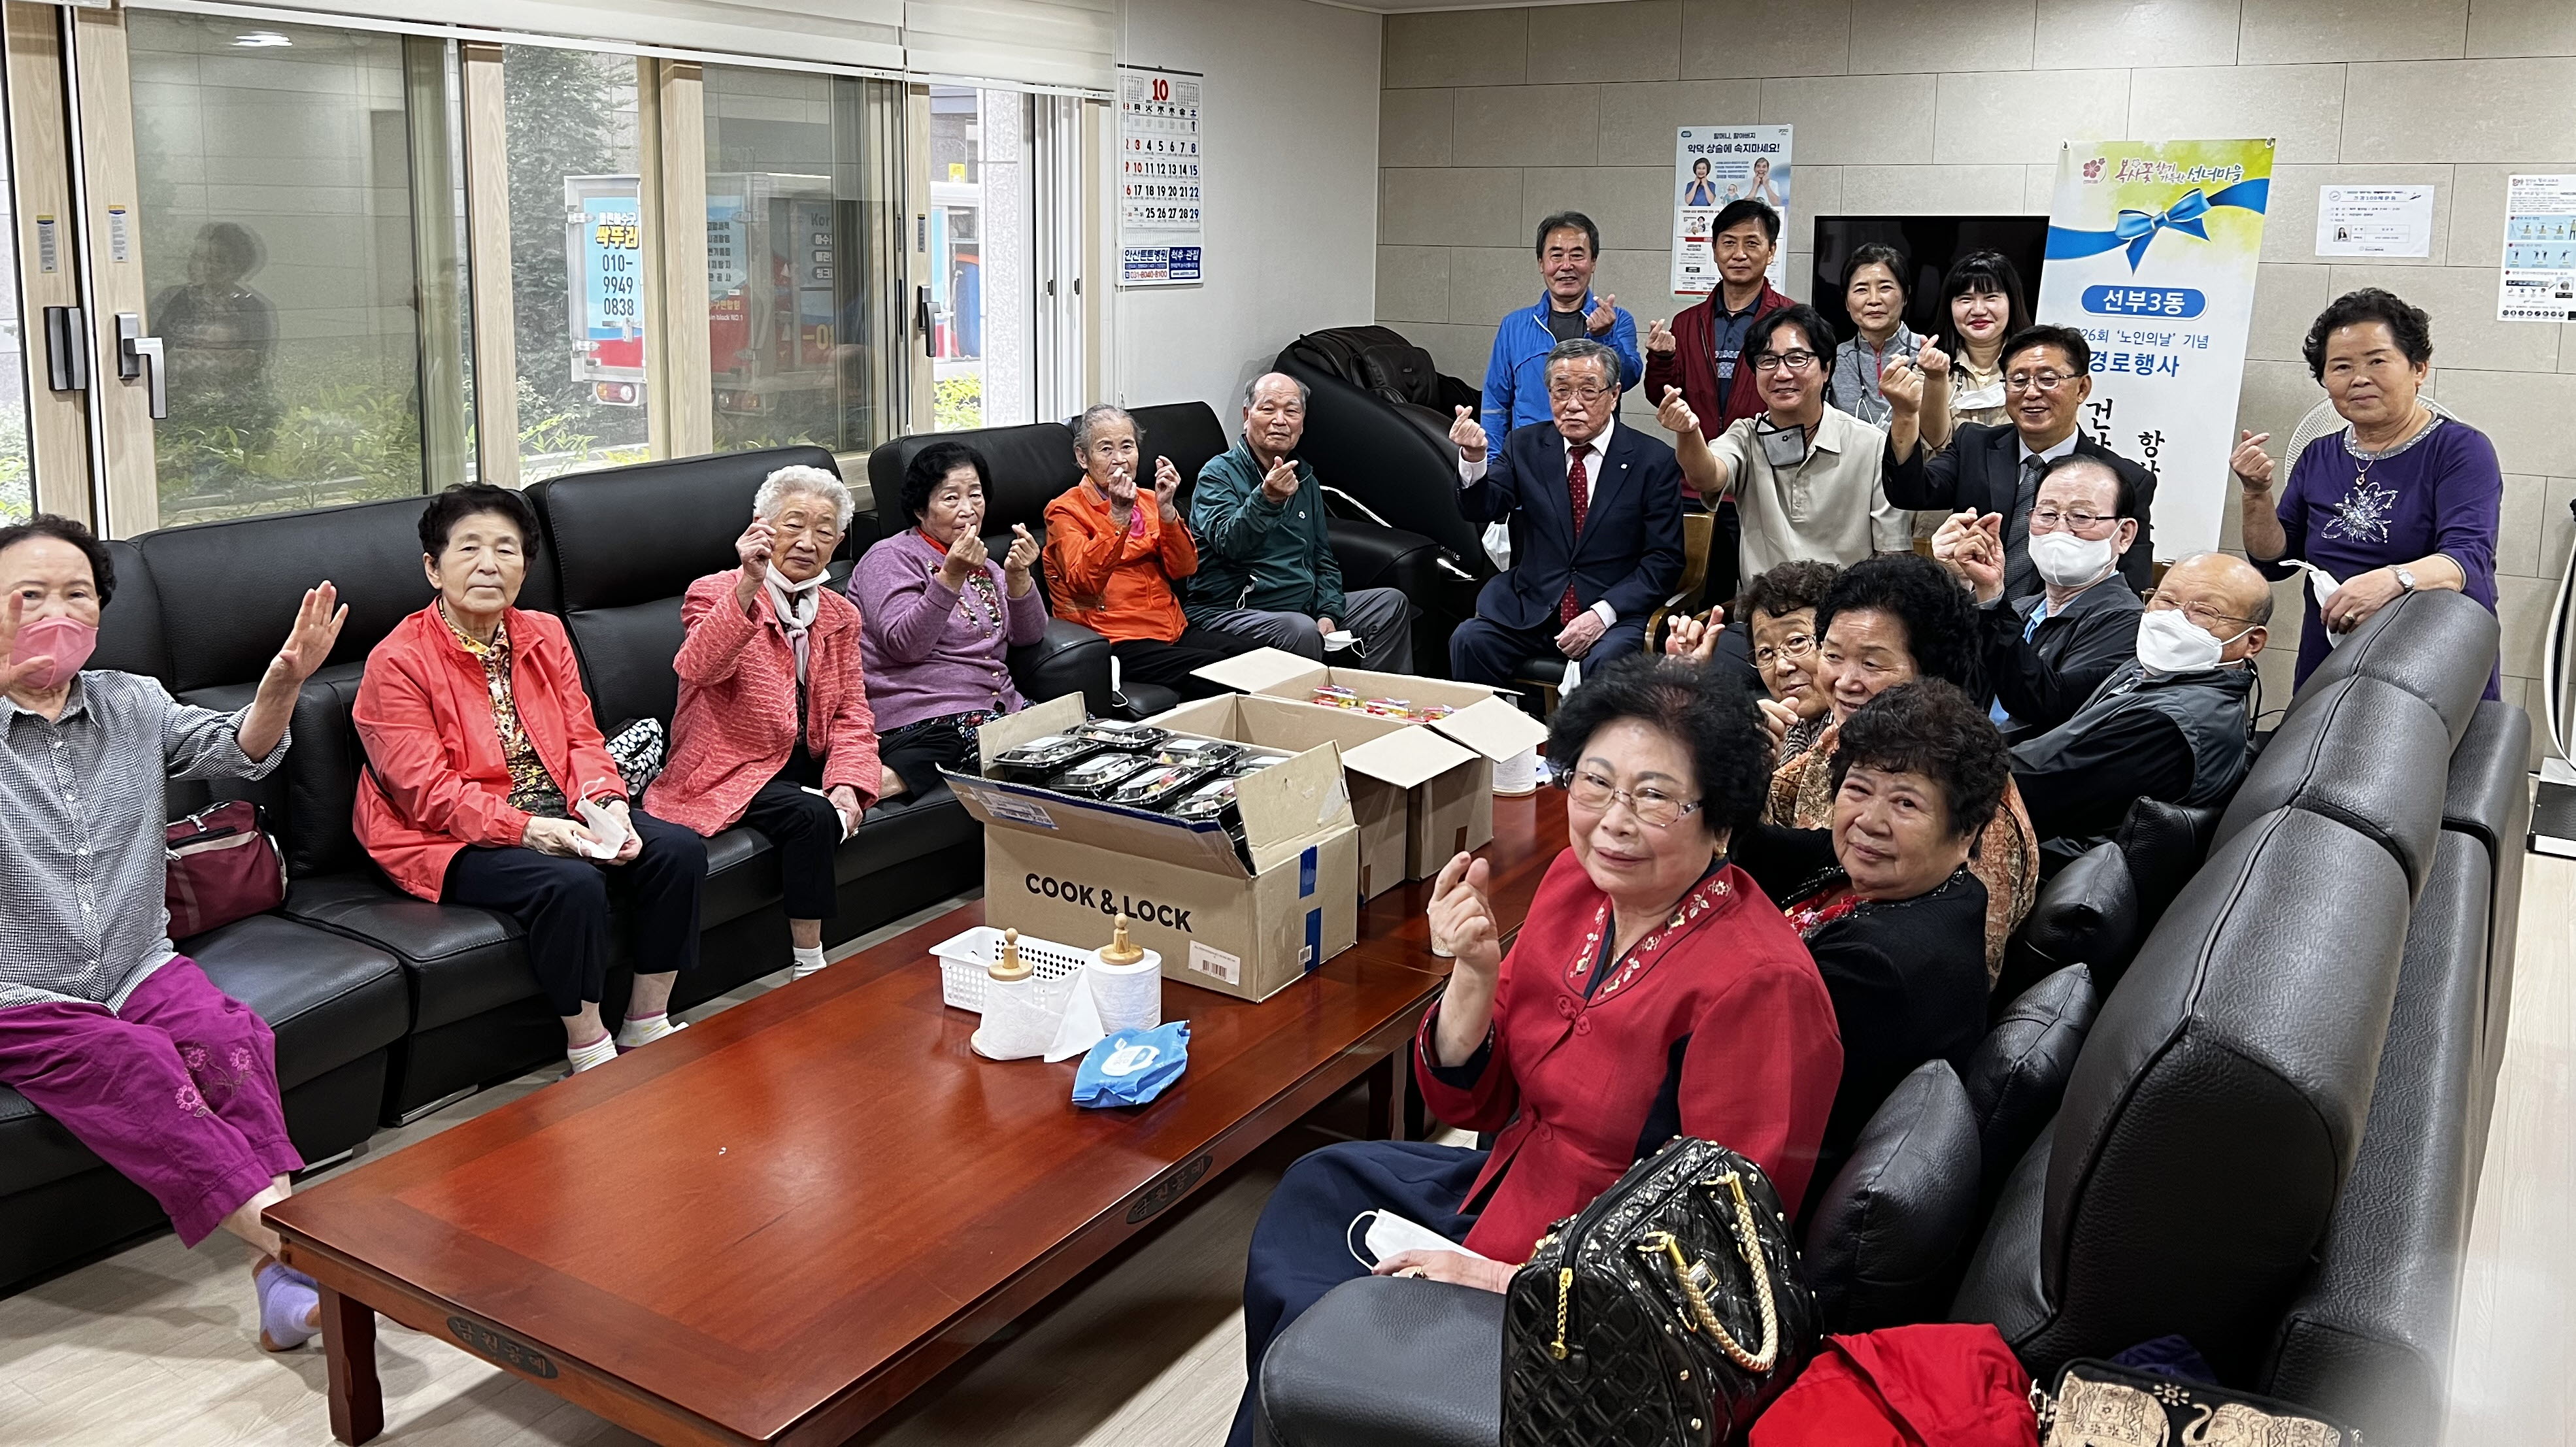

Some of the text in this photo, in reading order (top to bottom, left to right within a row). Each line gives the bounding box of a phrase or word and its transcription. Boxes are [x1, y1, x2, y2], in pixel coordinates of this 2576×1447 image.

[1152, 78, 1169, 101] 10
[1135, 139, 1140, 150] 3
[1146, 140, 1152, 151] 4
[1158, 141, 1163, 151] 5
[1170, 141, 1175, 152] 6
[1180, 142, 1185, 153] 7
[1191, 142, 1196, 153] 8
[1688, 143, 1780, 154] 악덕 상술에 속지마세요!
[1133, 162, 1142, 173] 10
[1145, 163, 1154, 174] 11
[1157, 163, 1165, 174] 12
[1169, 163, 1177, 175] 13
[1179, 164, 1186, 175] 14
[1190, 165, 1197, 176] 15
[2187, 165, 2243, 183] 선녀마을
[1134, 184, 1142, 196] 17
[1145, 185, 1154, 196] 18
[1157, 186, 1166, 196] 19
[1168, 186, 1177, 197] 20
[1179, 186, 1188, 197] 21
[1189, 186, 1199, 197] 22
[1145, 207, 1155, 218] 25
[1157, 208, 1166, 218] 26
[1168, 208, 1177, 219] 27
[1179, 208, 1188, 219] 28
[1189, 208, 1199, 219] 29
[602, 254, 633, 272] 010-
[603, 276, 633, 294] 9949
[604, 297, 634, 316] 0838
[2103, 290, 2185, 315] 선부3동
[2183, 334, 2209, 349] 기념
[2089, 351, 2180, 378] 경로행사
[1026, 873, 1192, 933] COOK & LOCK
